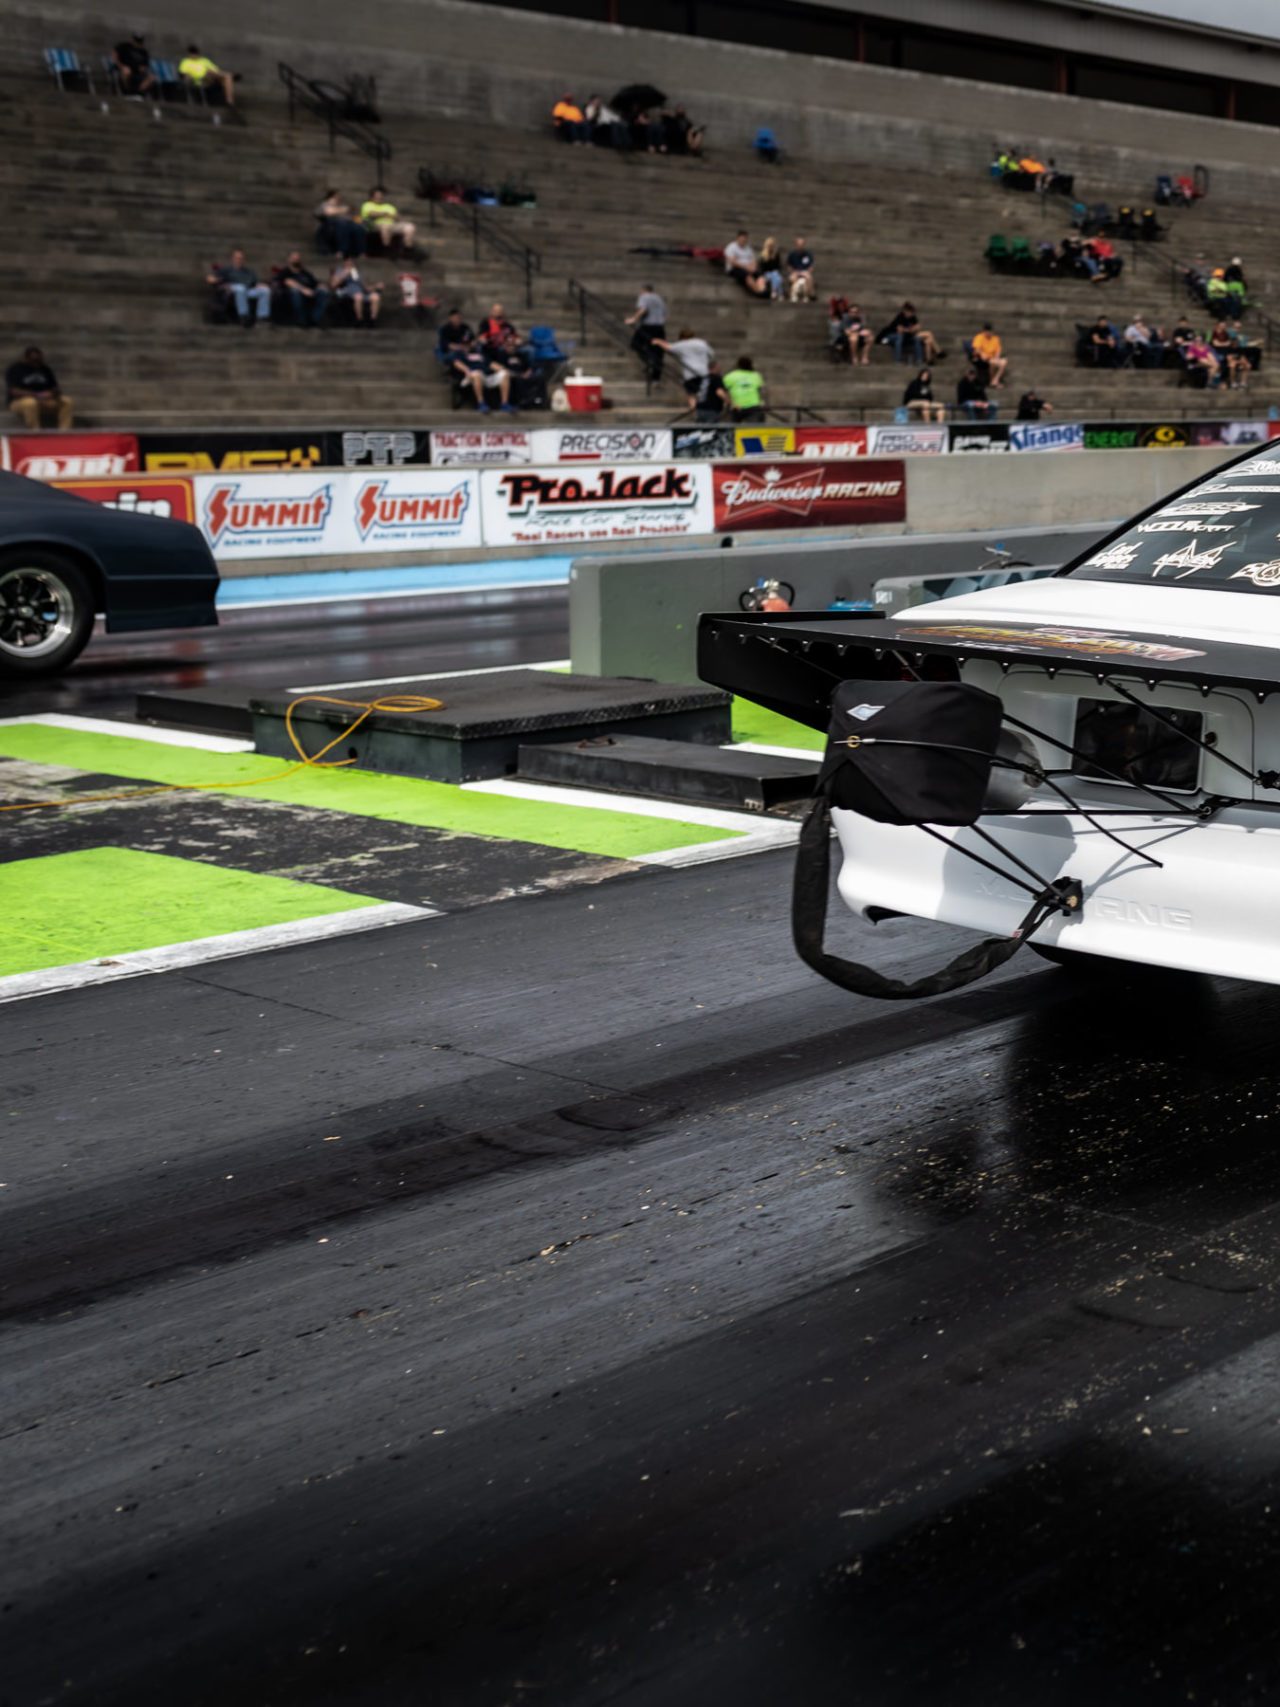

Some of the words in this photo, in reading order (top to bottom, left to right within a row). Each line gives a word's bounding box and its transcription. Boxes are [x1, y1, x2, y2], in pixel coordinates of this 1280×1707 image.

[434, 433, 482, 447] TRACTION
[486, 432, 528, 447] CONTROL
[559, 433, 656, 451] PRECISION
[342, 432, 416, 466] PTP
[720, 480, 824, 505] Budweiser
[823, 481, 902, 499] RACING
[372, 530, 408, 540] RACING
[410, 529, 462, 539] EQUIPMENT
[546, 529, 585, 540] Racers
[588, 528, 608, 538] use
[612, 526, 635, 536] Real
[224, 537, 263, 546] RACING
[265, 536, 323, 545] EQUIPMENT
